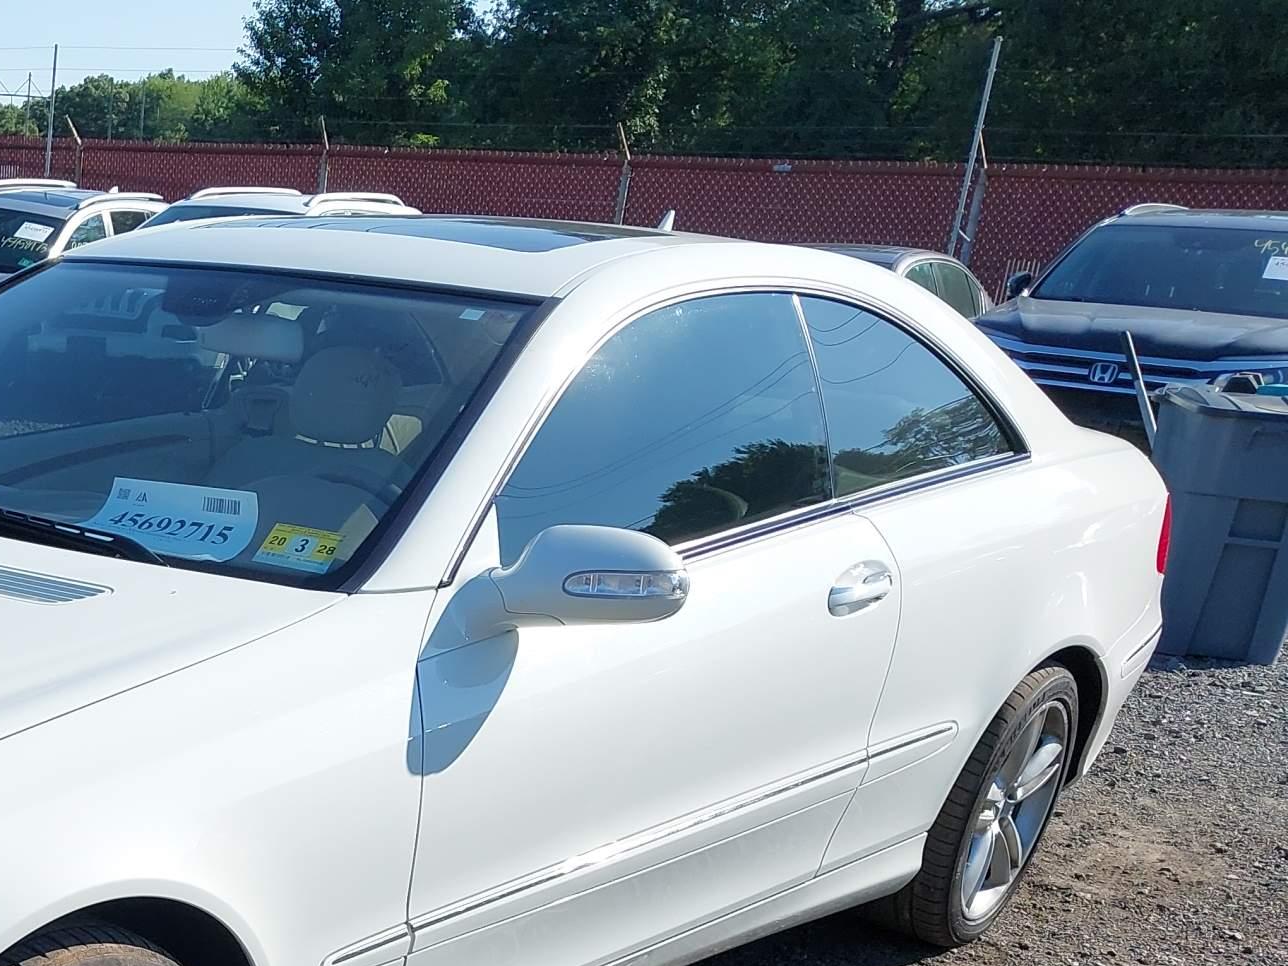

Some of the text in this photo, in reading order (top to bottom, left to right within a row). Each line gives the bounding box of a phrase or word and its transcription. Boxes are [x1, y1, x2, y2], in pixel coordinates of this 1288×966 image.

[108, 511, 236, 545] 45692715
[268, 535, 337, 556] 20 3 28
